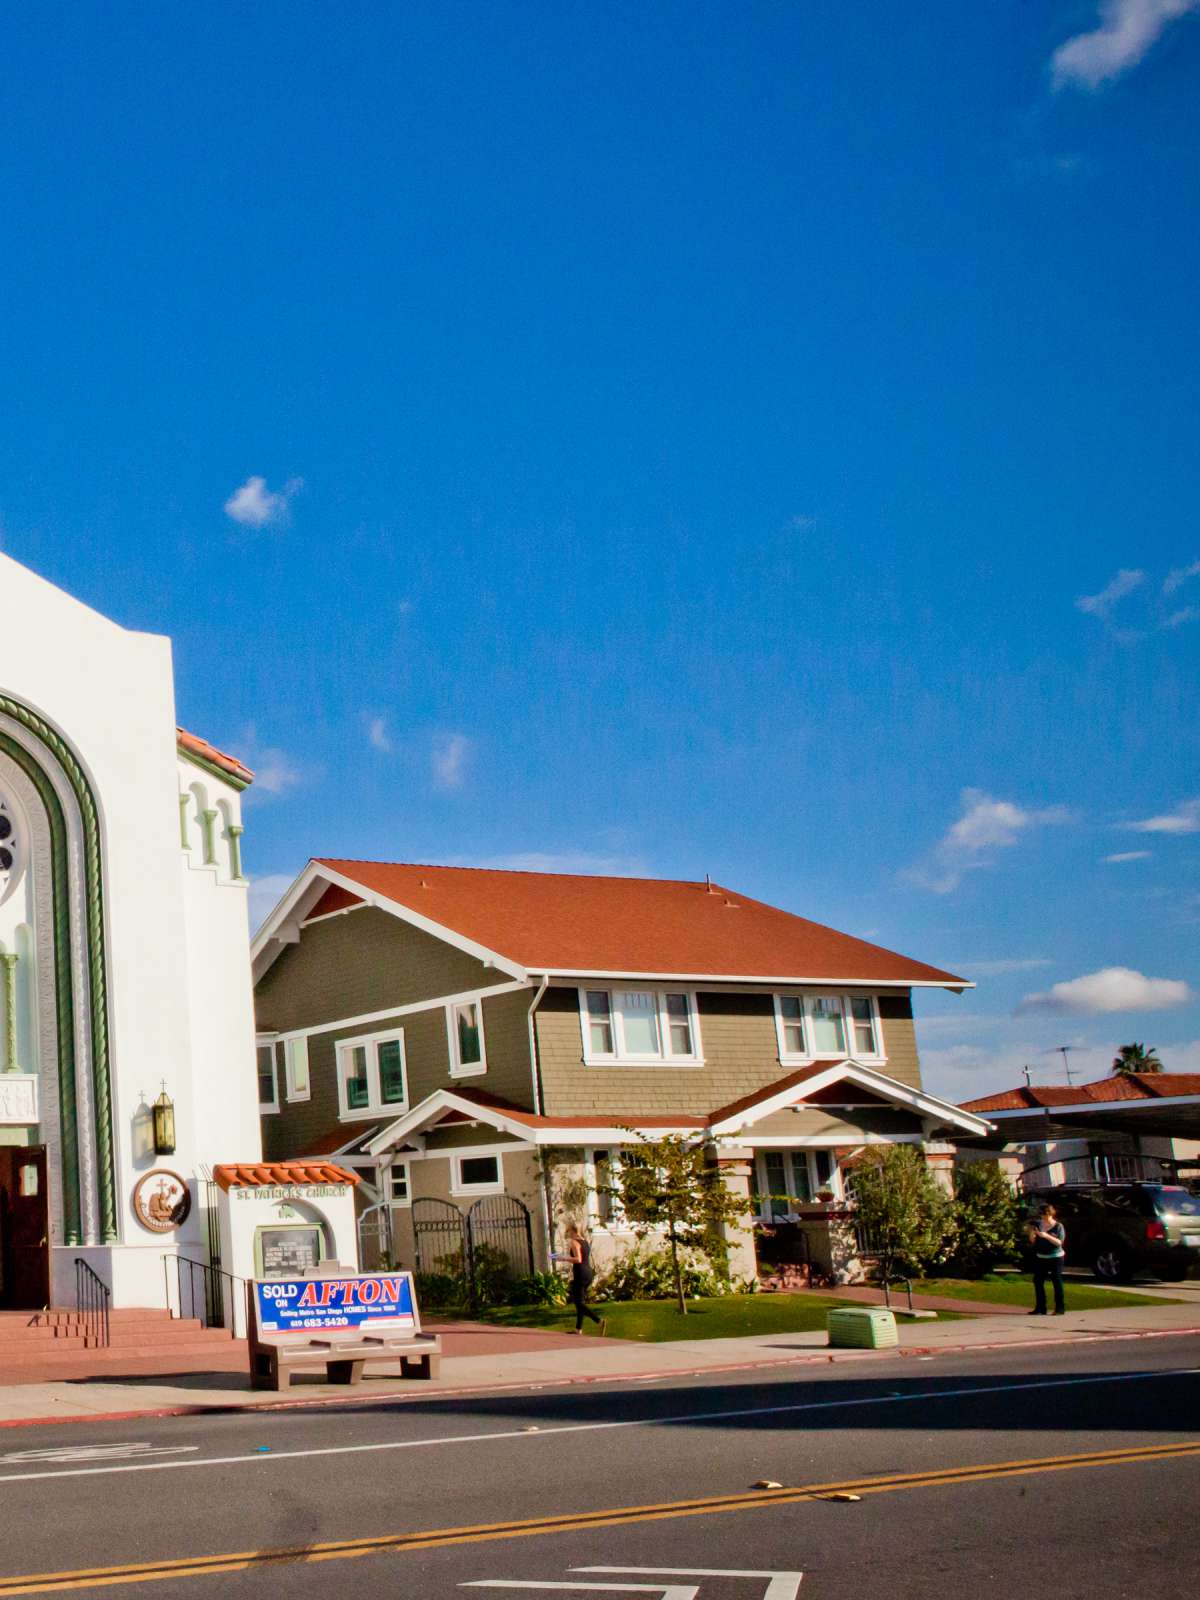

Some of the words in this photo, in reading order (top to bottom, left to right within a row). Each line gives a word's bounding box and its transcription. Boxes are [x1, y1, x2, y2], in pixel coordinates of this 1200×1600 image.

[306, 1185, 346, 1198] CHURCH
[262, 1284, 298, 1299] SOLD
[297, 1279, 403, 1306] AFTON
[275, 1299, 288, 1308] ON
[344, 1305, 367, 1313] HOMES
[290, 1319, 303, 1327] 619
[303, 1316, 349, 1328] 683-5420
